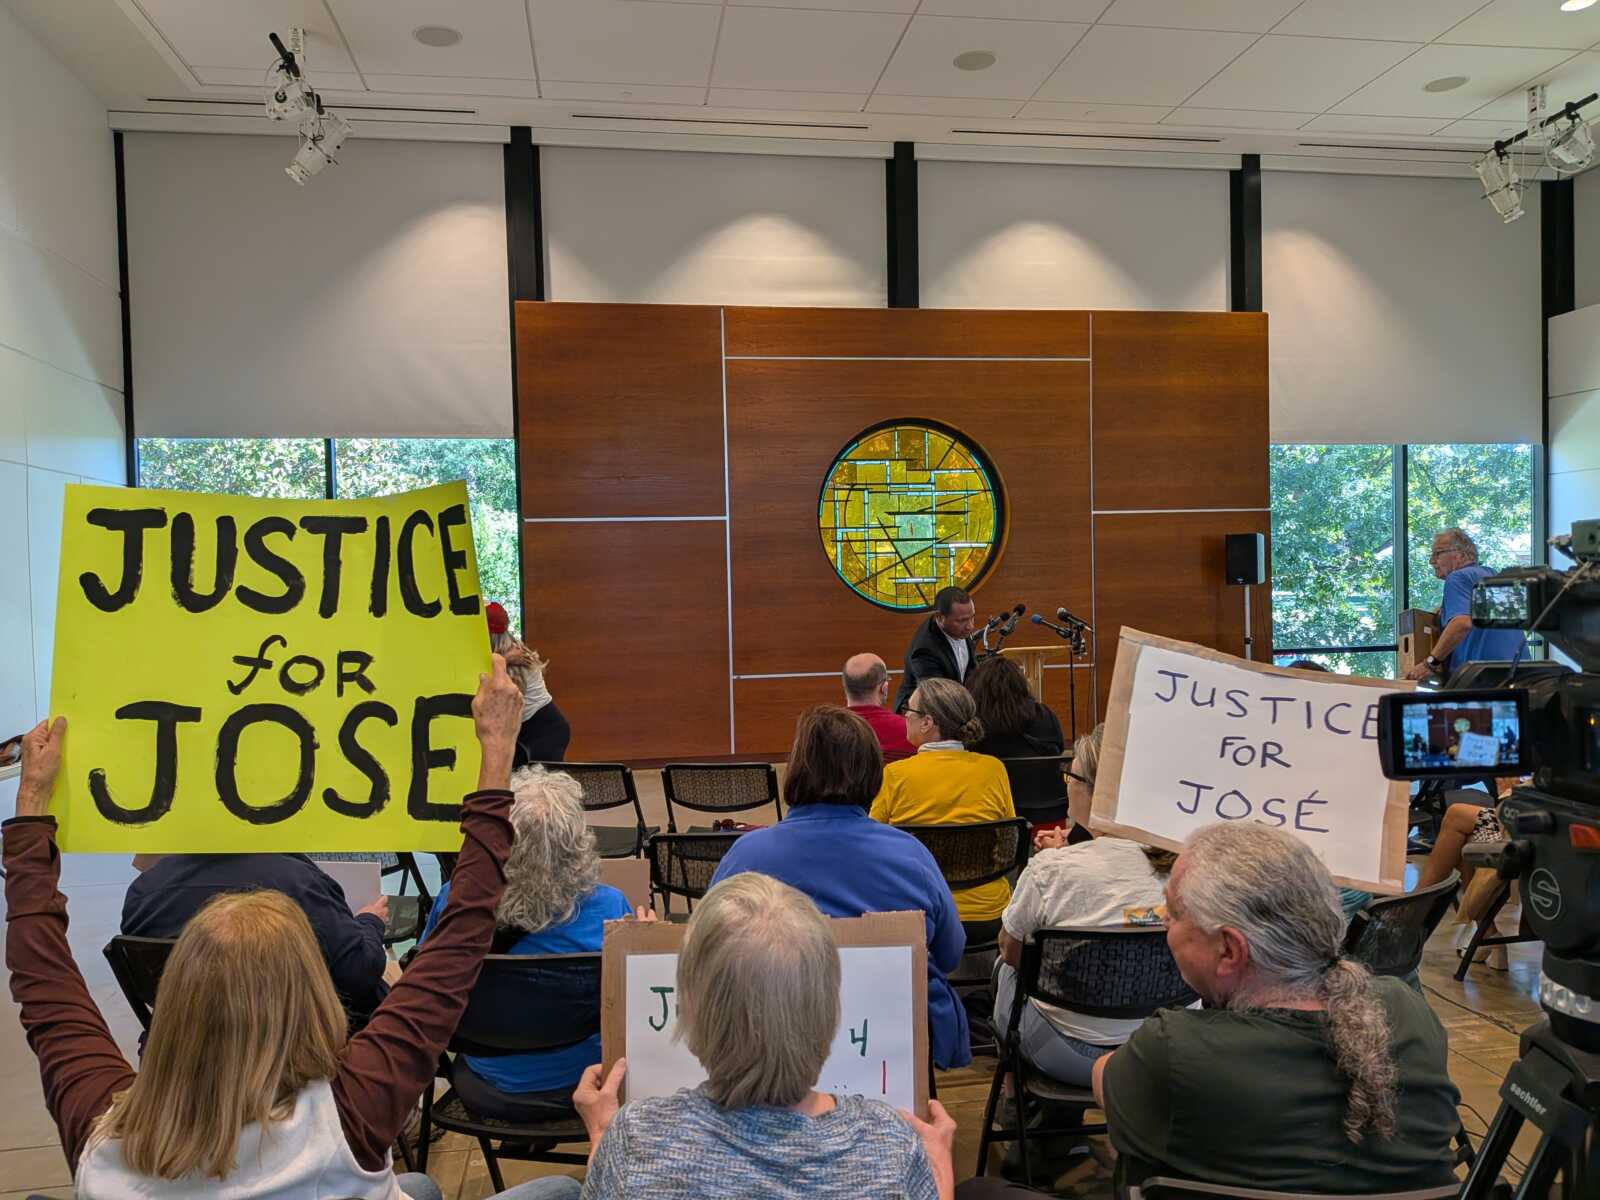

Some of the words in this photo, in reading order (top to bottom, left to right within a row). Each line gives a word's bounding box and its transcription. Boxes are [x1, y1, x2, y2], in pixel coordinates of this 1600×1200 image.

[79, 504, 481, 619] JUSTICE
[1155, 669, 1380, 740] JUSTICE
[88, 694, 475, 825] JOSE
[1219, 736, 1291, 769] FOR
[1176, 780, 1330, 834] JOSÉ
